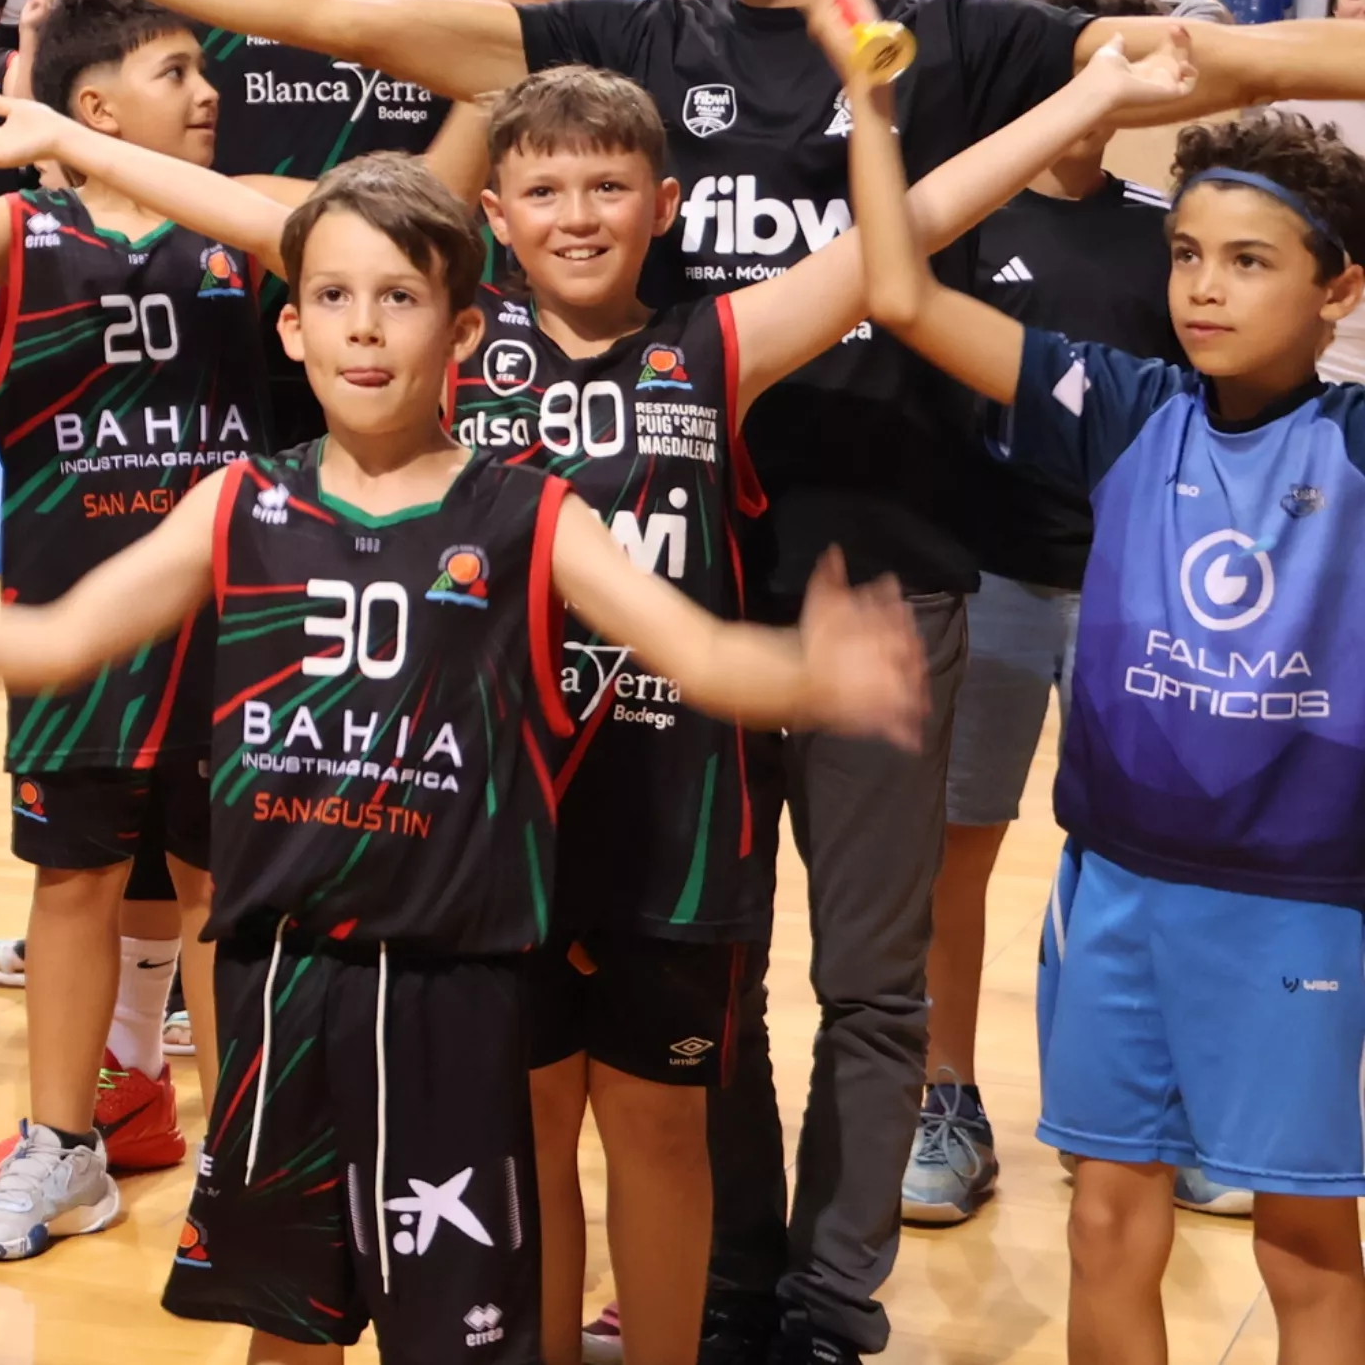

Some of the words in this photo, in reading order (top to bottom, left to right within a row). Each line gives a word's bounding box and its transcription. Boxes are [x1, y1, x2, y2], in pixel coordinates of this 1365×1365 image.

[378, 105, 428, 123] Bodega
[694, 89, 730, 105] fibwi
[680, 174, 855, 256] fibw
[100, 293, 179, 364] 20
[54, 404, 249, 452] BAHIA
[538, 380, 626, 458] 80
[634, 401, 718, 421] RESTAURANT
[636, 414, 672, 435] PUIG
[458, 411, 531, 447] alsa
[637, 435, 716, 464] MAGDALENA
[83, 493, 123, 519] SAN
[302, 578, 408, 679] 30
[1125, 662, 1330, 721] ÓPTICOS
[614, 703, 676, 730] Bodega
[243, 700, 463, 768] BAHIA
[253, 792, 310, 824] SAN
